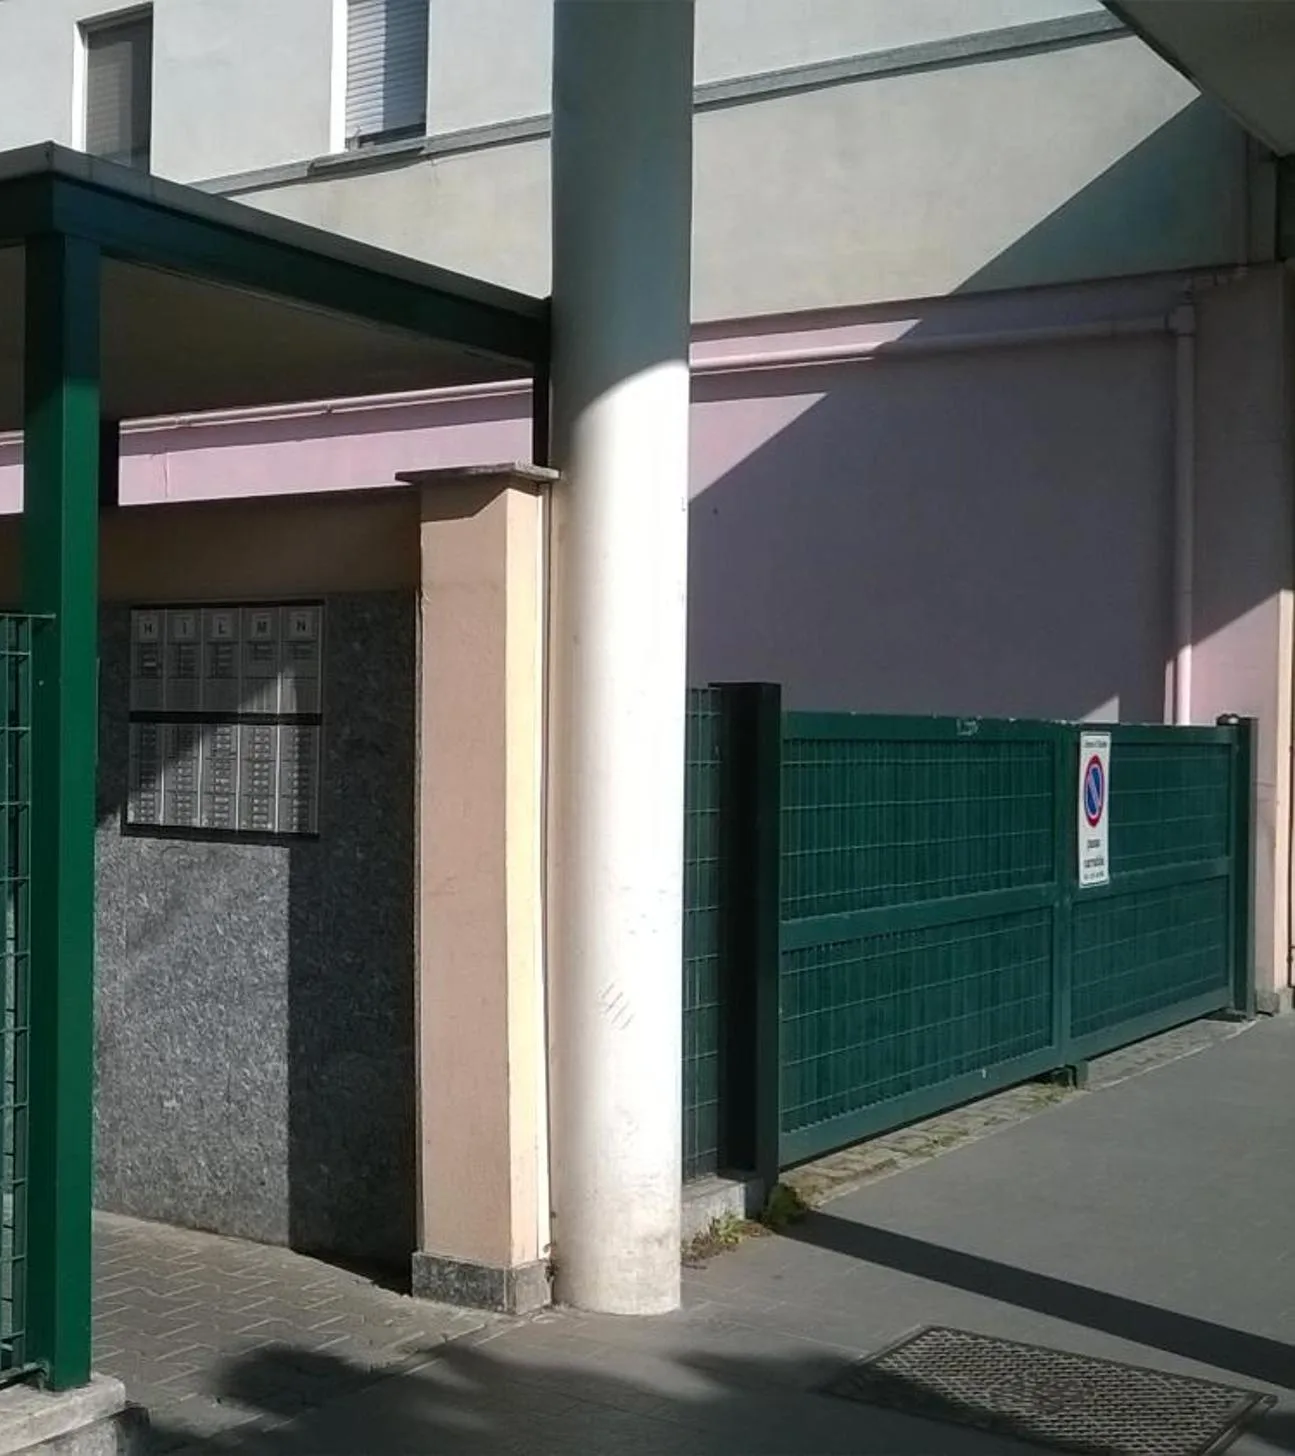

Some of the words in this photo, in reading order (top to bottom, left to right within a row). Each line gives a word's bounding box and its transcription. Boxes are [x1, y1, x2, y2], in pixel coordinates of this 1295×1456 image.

[143, 622, 153, 634] H
[218, 622, 226, 635] L
[296, 620, 306, 633] N
